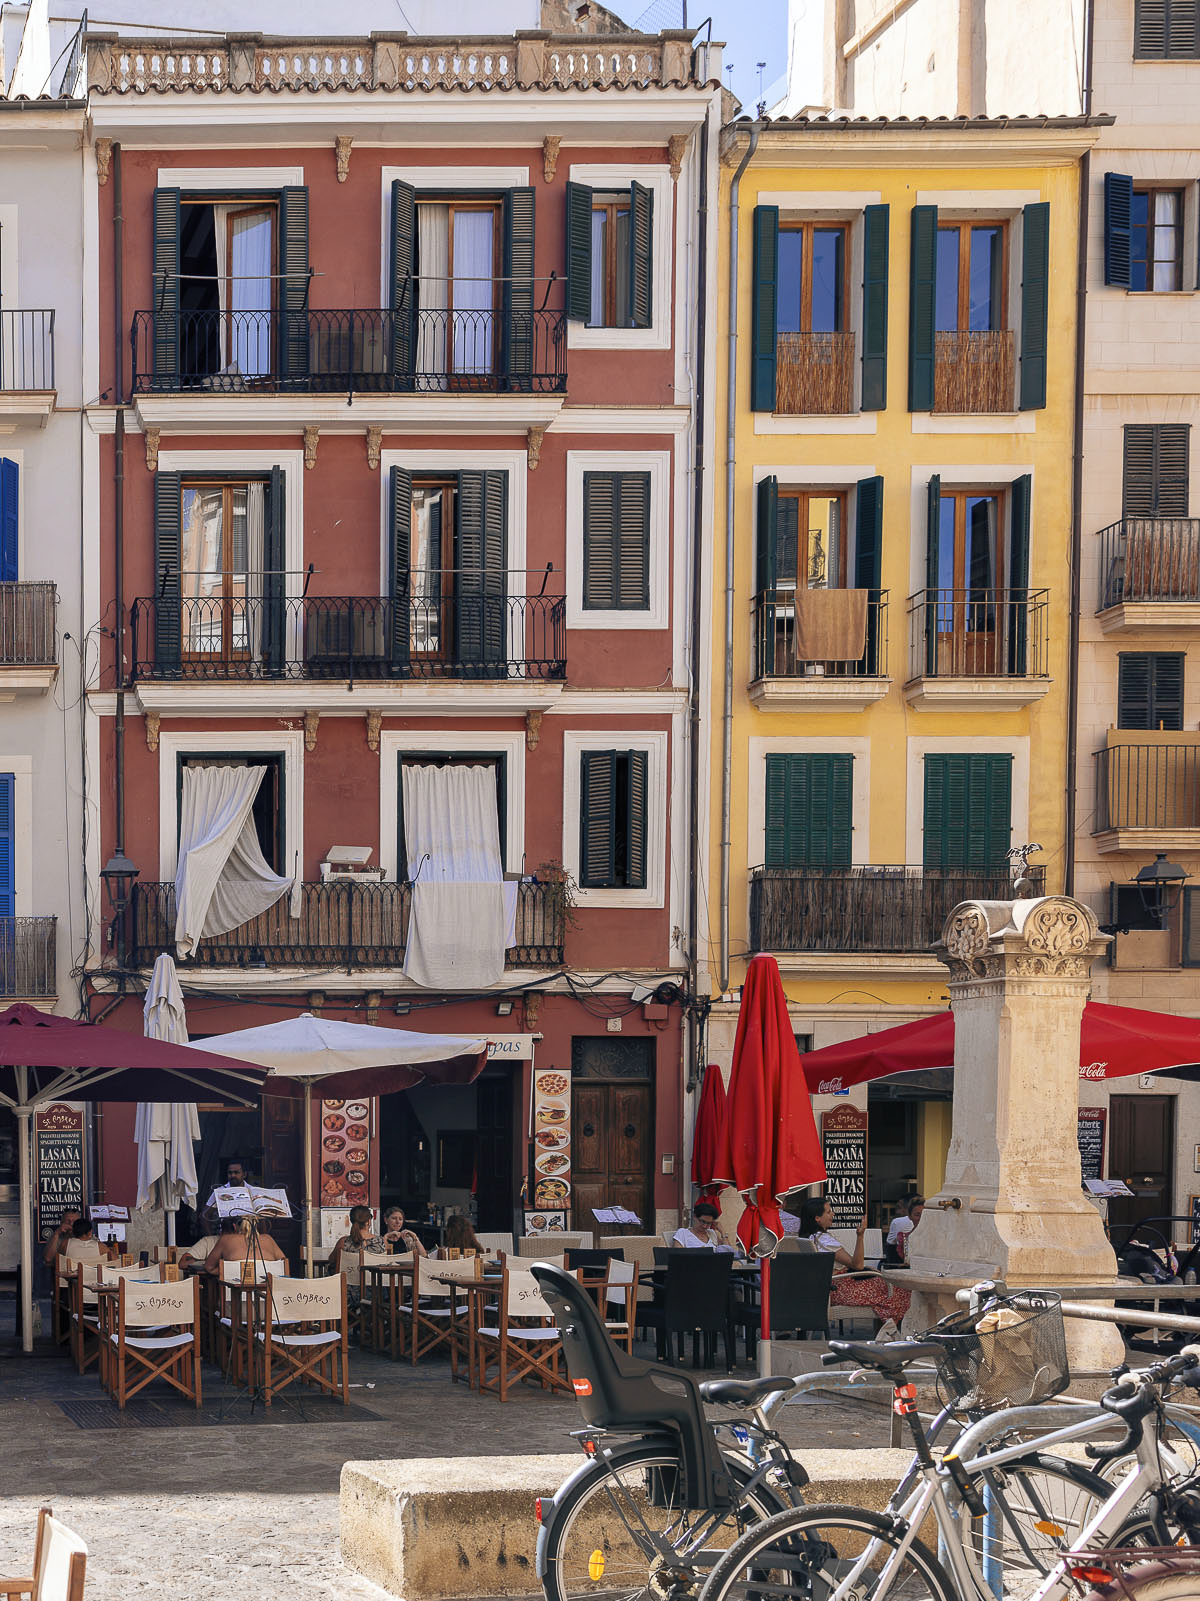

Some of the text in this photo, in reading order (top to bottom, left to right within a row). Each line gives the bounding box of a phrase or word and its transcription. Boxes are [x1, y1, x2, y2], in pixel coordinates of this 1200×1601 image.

[488, 1041, 521, 1057] apas
[1145, 1076, 1150, 1086] 7
[40, 1145, 80, 1160] LASAÑA
[826, 1144, 864, 1160] LASAÑA
[40, 1161, 80, 1169] PIZZA CASERA
[825, 1161, 864, 1169] PIZZA CASERA
[40, 1176, 81, 1193] TAPAS
[826, 1177, 864, 1194] TAPAS
[41, 1193, 82, 1203] ENSALADAS
[831, 1206, 864, 1214] MBURGUESA
